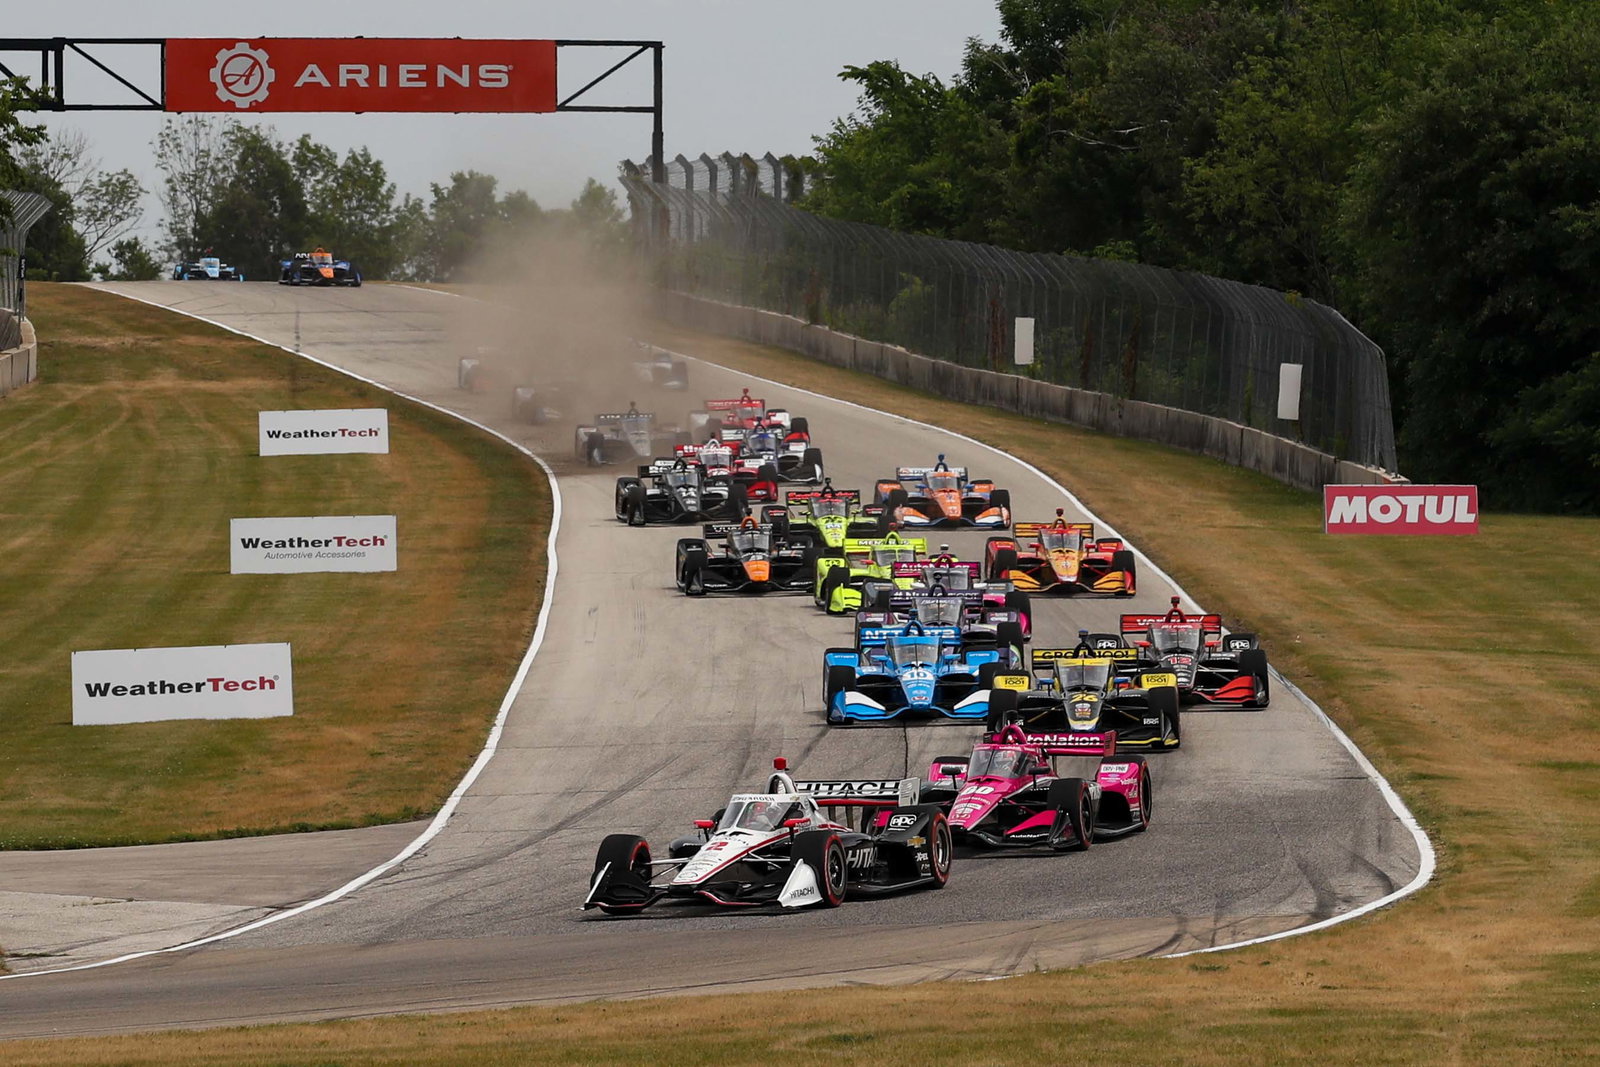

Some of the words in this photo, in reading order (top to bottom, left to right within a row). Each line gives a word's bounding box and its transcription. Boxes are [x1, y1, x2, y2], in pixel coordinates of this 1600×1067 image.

[293, 64, 510, 88] ARIENS
[266, 428, 379, 439] WeatherTech
[1328, 495, 1476, 524] MOTUL
[240, 535, 386, 549] WeatherTech
[264, 551, 313, 560] Automotive
[314, 550, 366, 559] Accessories
[1098, 641, 1116, 649] PPG
[1231, 641, 1250, 649] PPG
[1168, 657, 1192, 665] 12
[908, 671, 928, 679] 10
[85, 676, 276, 697] WeatherTech
[1071, 694, 1098, 703] 26
[1006, 734, 1100, 747] AtoNation
[796, 781, 900, 796] HITACH
[891, 815, 915, 827] PPG
[705, 842, 728, 851] 2
[790, 886, 815, 899] HITACHI
